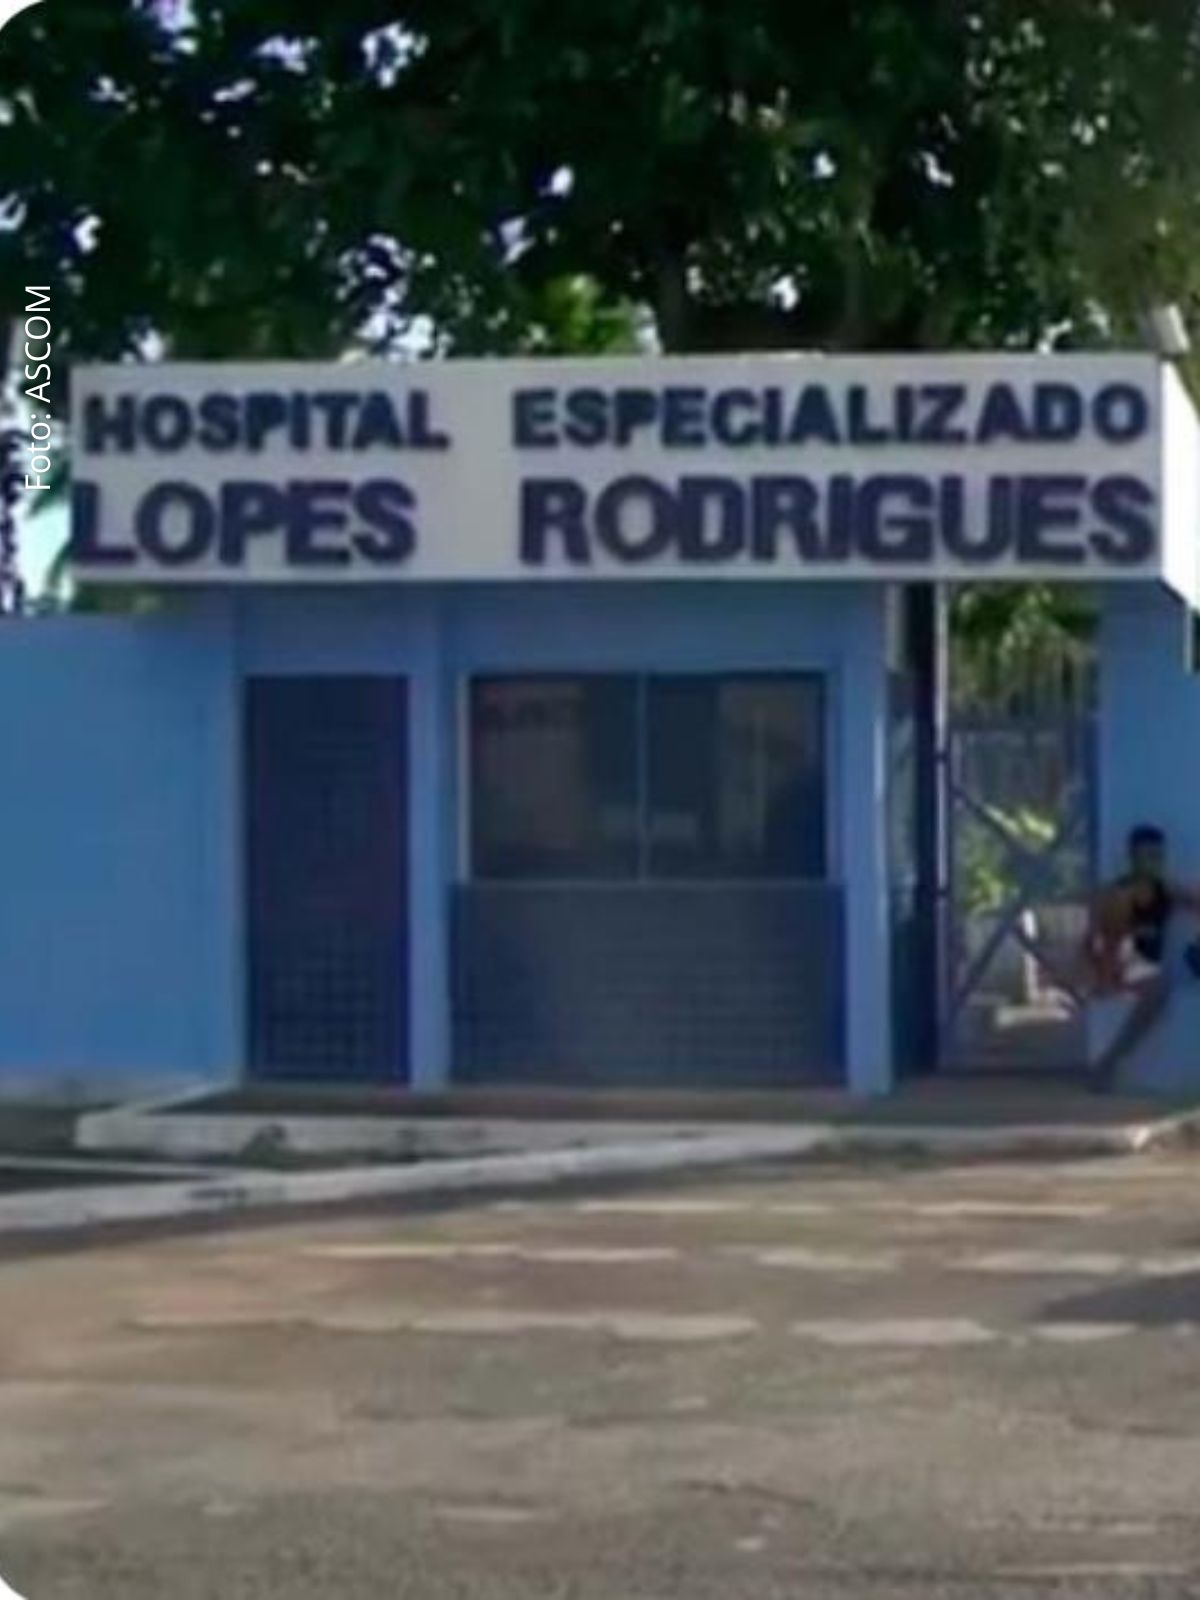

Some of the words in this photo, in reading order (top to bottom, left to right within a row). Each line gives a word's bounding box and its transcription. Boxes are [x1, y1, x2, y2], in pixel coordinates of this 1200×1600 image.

[84, 389, 450, 453] HOSPITAL
[512, 381, 1149, 449] ESPECIALIZADO
[72, 479, 417, 567] LOPES
[518, 473, 1158, 567] RODRIGUES
